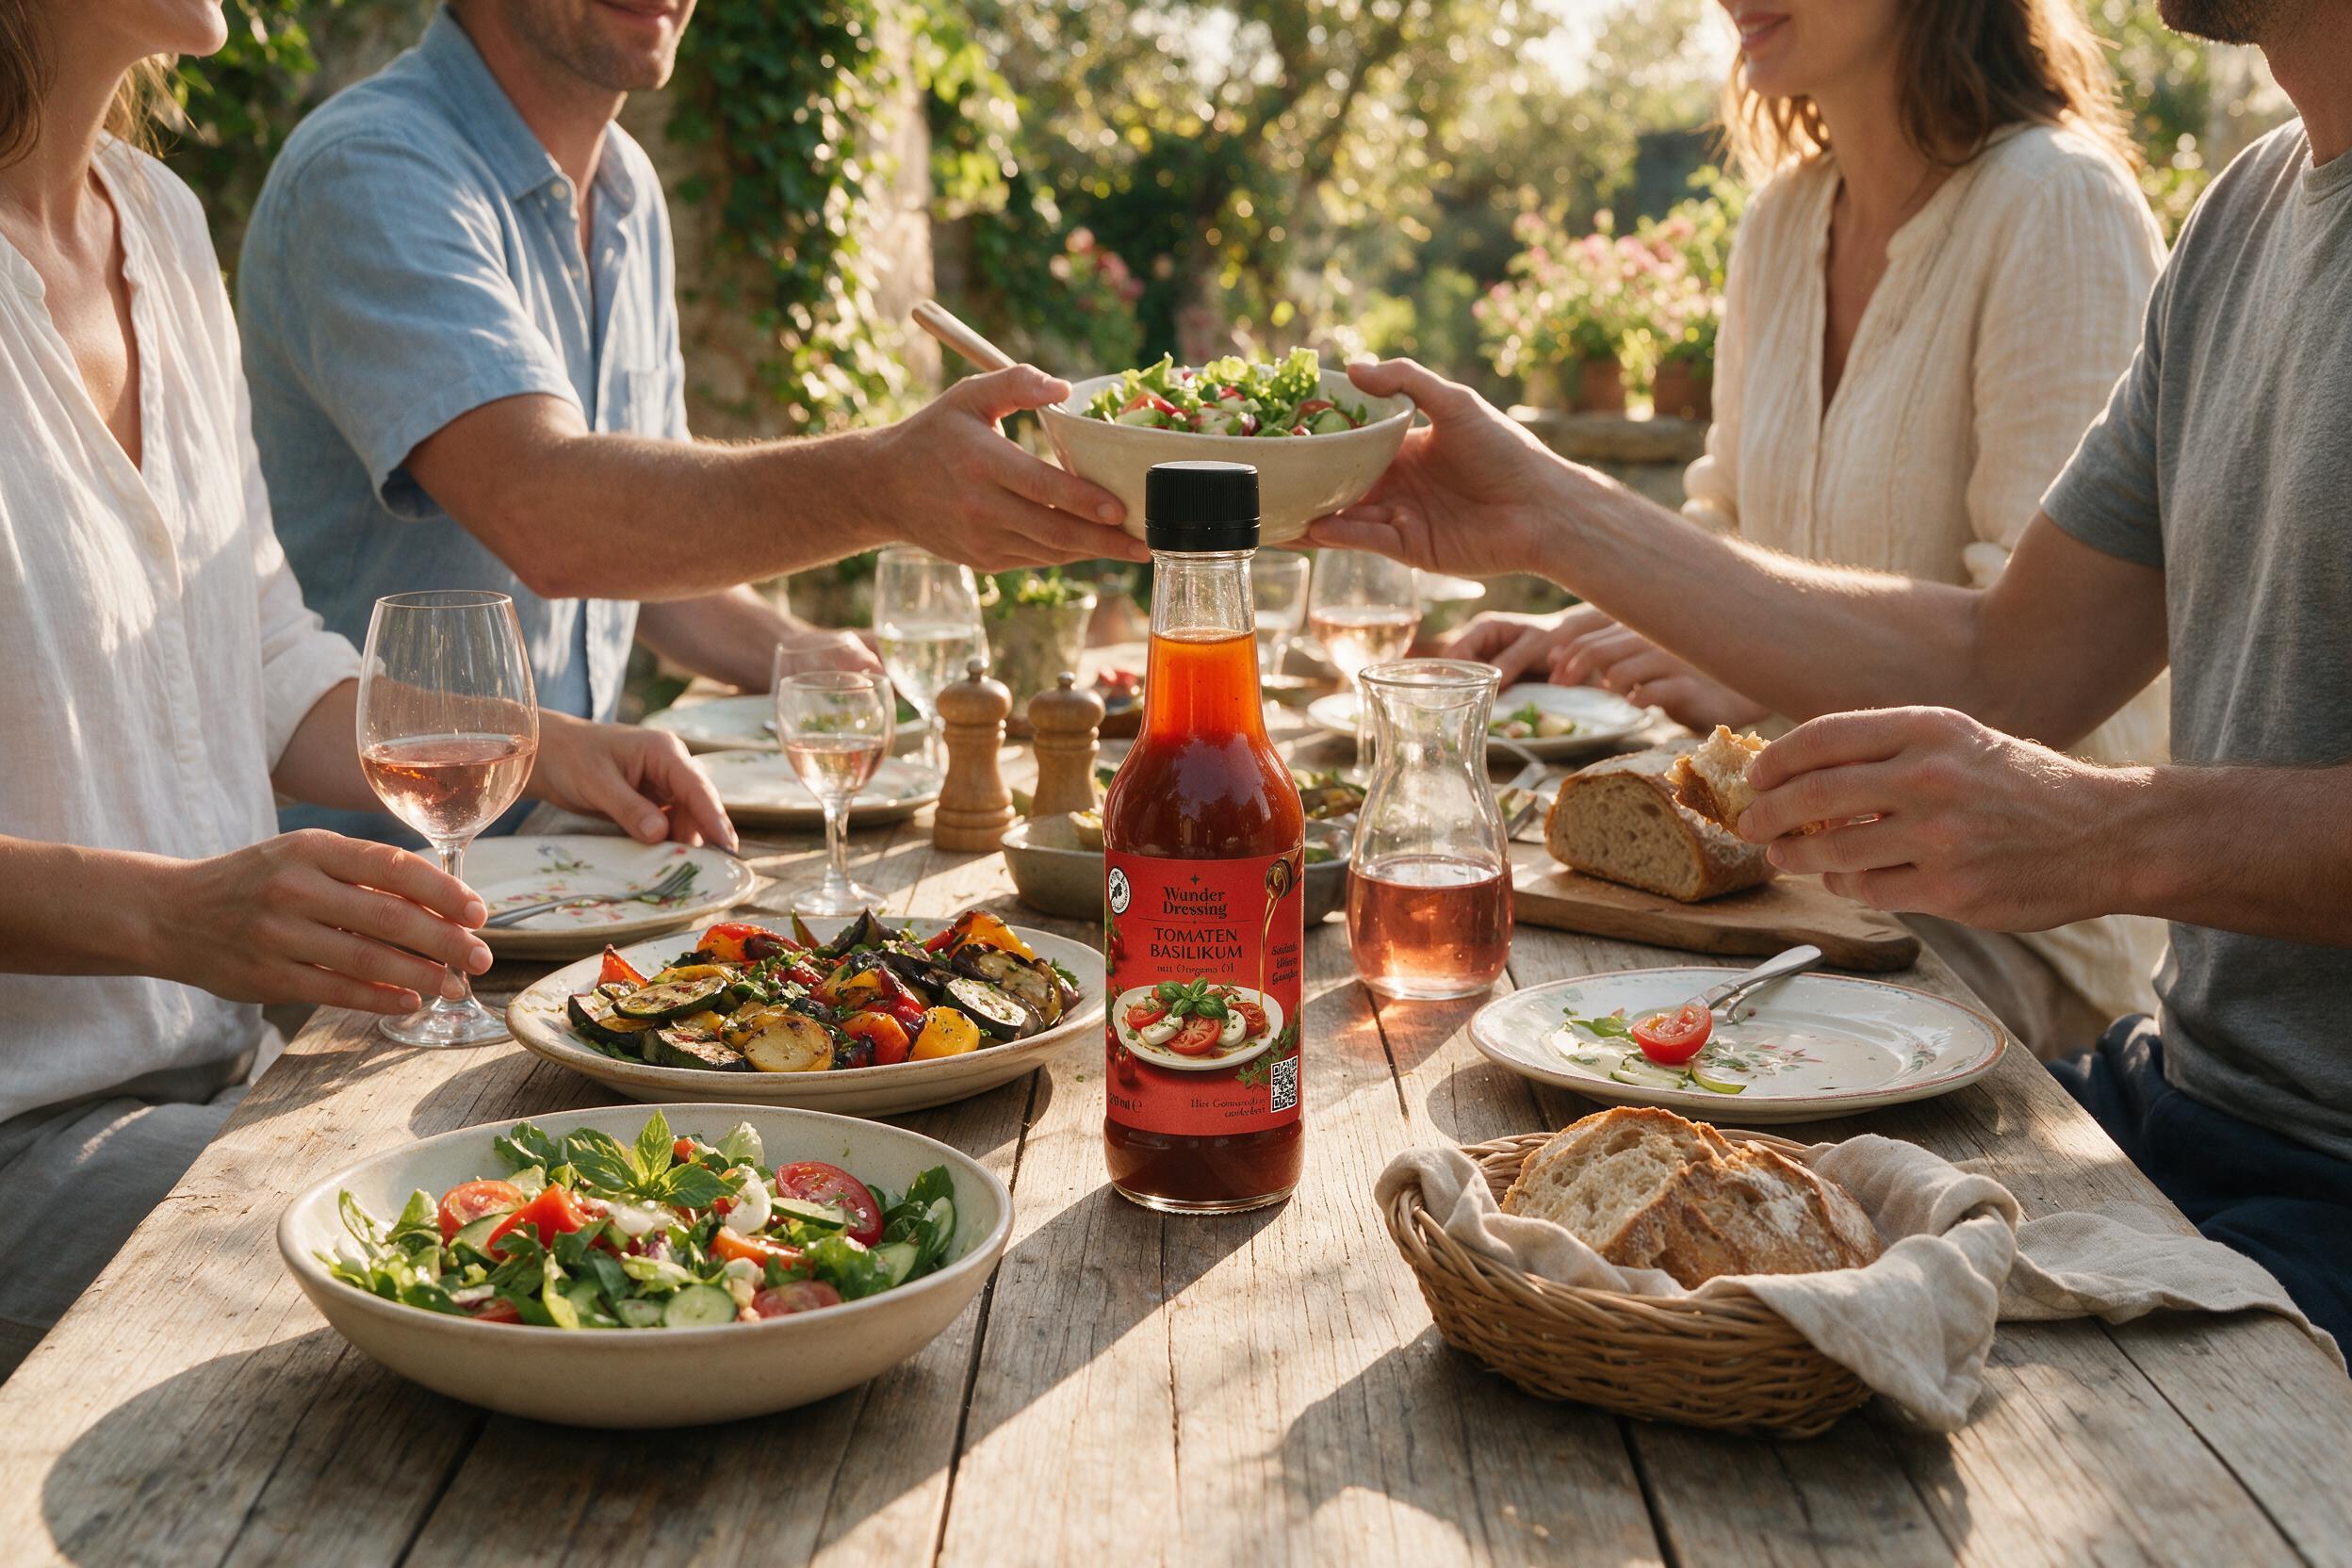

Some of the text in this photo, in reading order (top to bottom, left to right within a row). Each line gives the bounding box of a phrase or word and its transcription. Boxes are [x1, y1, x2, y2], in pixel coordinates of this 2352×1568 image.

[1162, 886, 1227, 902] Wunder
[1163, 901, 1229, 920] Dressing
[1153, 927, 1238, 943] TOMATEN
[1151, 943, 1244, 960] BASILIKUM
